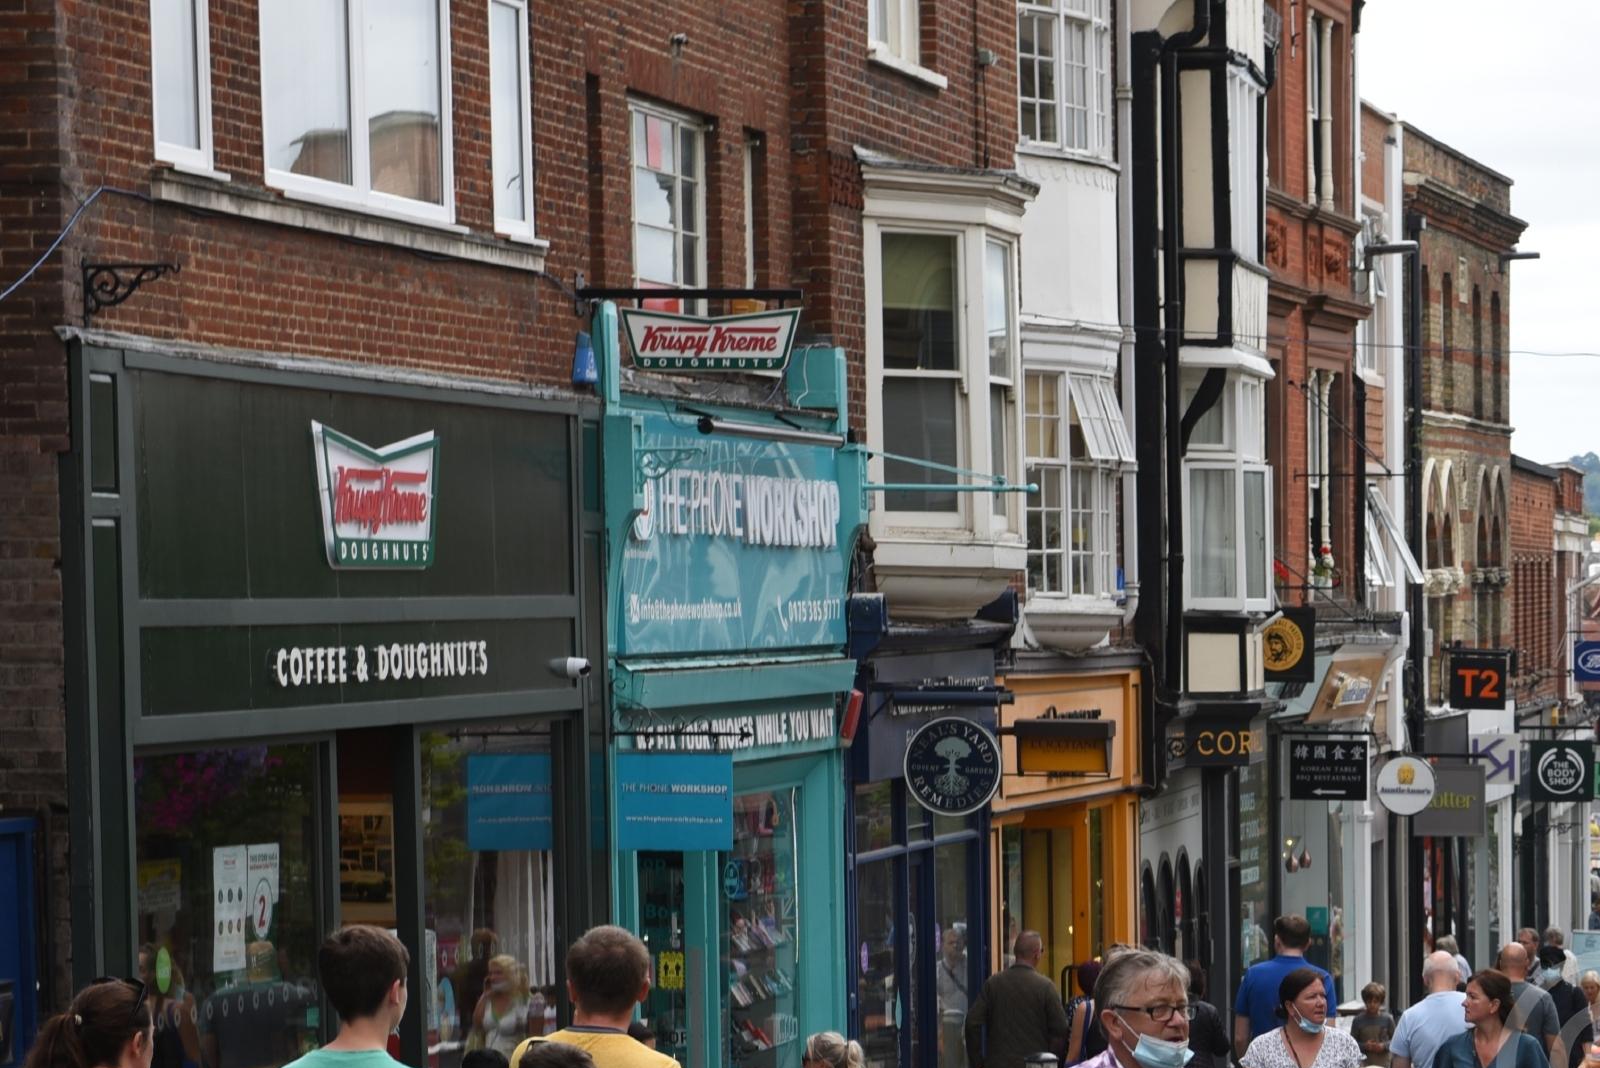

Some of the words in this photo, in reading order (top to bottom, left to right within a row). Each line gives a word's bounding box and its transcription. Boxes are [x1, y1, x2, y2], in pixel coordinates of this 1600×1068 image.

[640, 325, 713, 357] Krispy
[709, 325, 781, 353] Kreme
[643, 358, 775, 368] DOUGHNUTS
[335, 465, 385, 534] Krispy
[382, 466, 429, 526] Kreme
[658, 468, 687, 535] THE
[688, 470, 744, 537] PHONE
[745, 475, 840, 548] WORKSHOP
[341, 541, 429, 561] DOUGHNUTS
[277, 646, 347, 687] COFFEE
[357, 644, 369, 682] &
[378, 640, 488, 681] DOUGHNUTS
[1457, 668, 1499, 699] T2
[756, 711, 788, 745] WHILE
[789, 708, 809, 741] YOU
[810, 707, 835, 738] WAIT
[963, 724, 995, 765] YARD
[1547, 769, 1577, 778] BODY
[1553, 761, 1569, 769] THE
[621, 784, 637, 793] THE
[639, 784, 669, 793] PHONE
[671, 784, 728, 794] WORKSHOP
[913, 775, 992, 810] REMEDIES
[1548, 777, 1575, 786] SHOP
[1429, 792, 1473, 809] otter
[258, 895, 266, 928] 2
